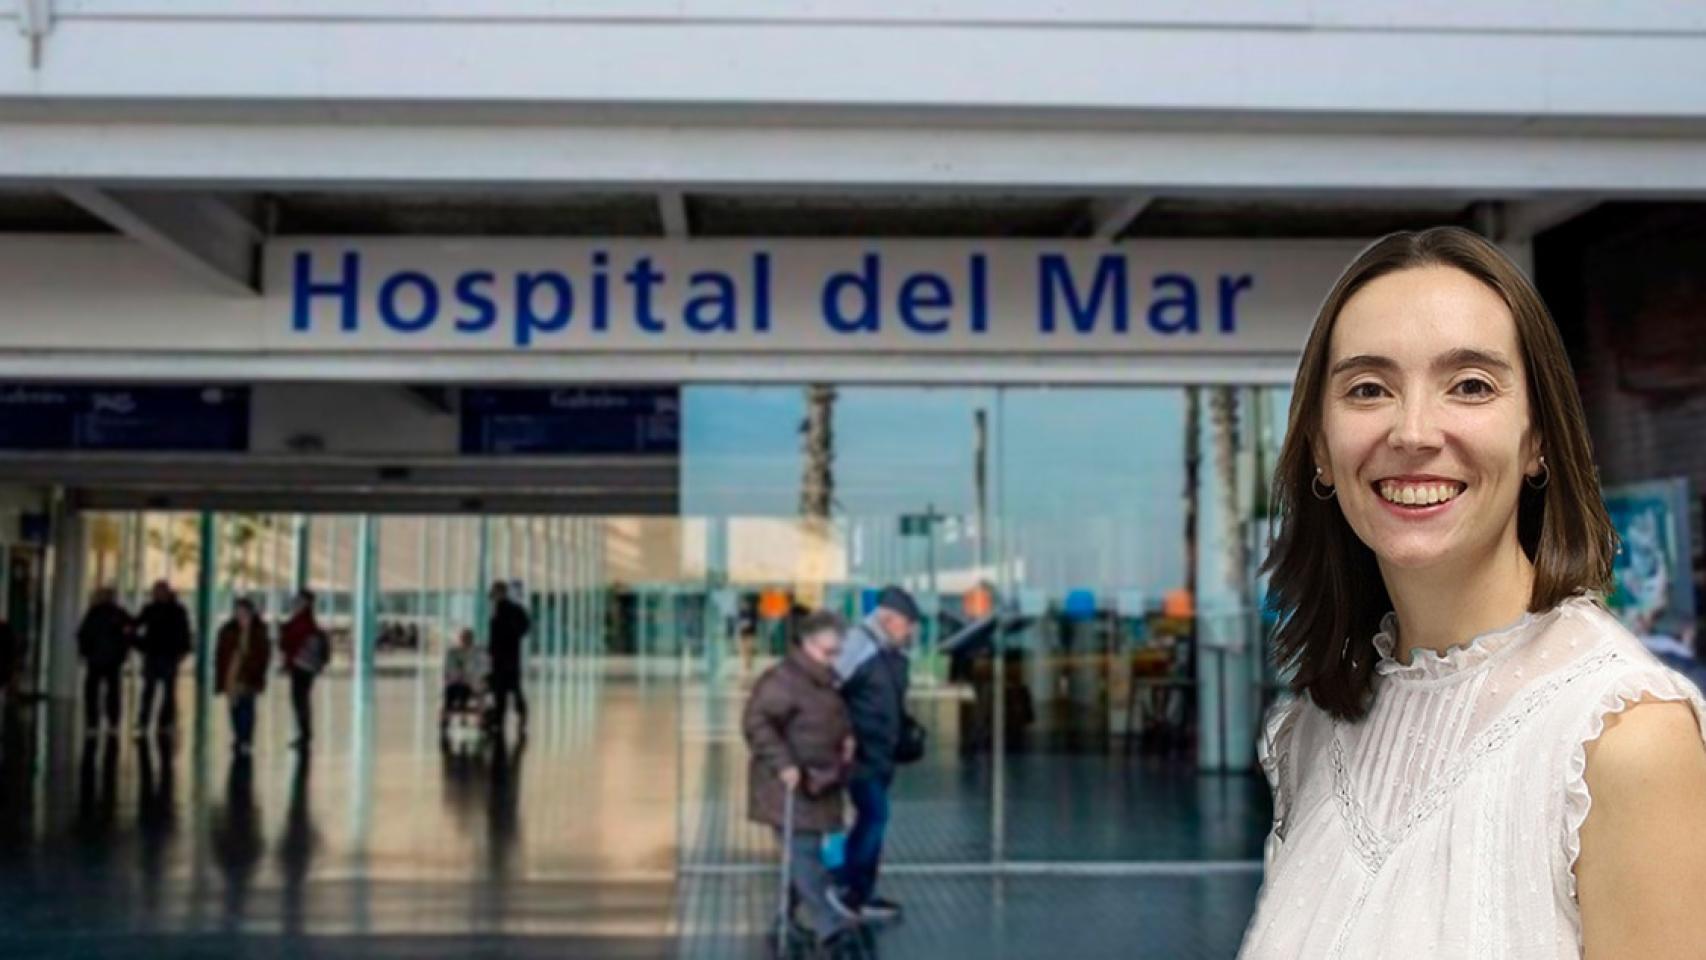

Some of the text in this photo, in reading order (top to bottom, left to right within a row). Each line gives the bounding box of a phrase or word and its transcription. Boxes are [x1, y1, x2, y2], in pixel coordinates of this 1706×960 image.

[291, 252, 1253, 346] Hospital del Mar
